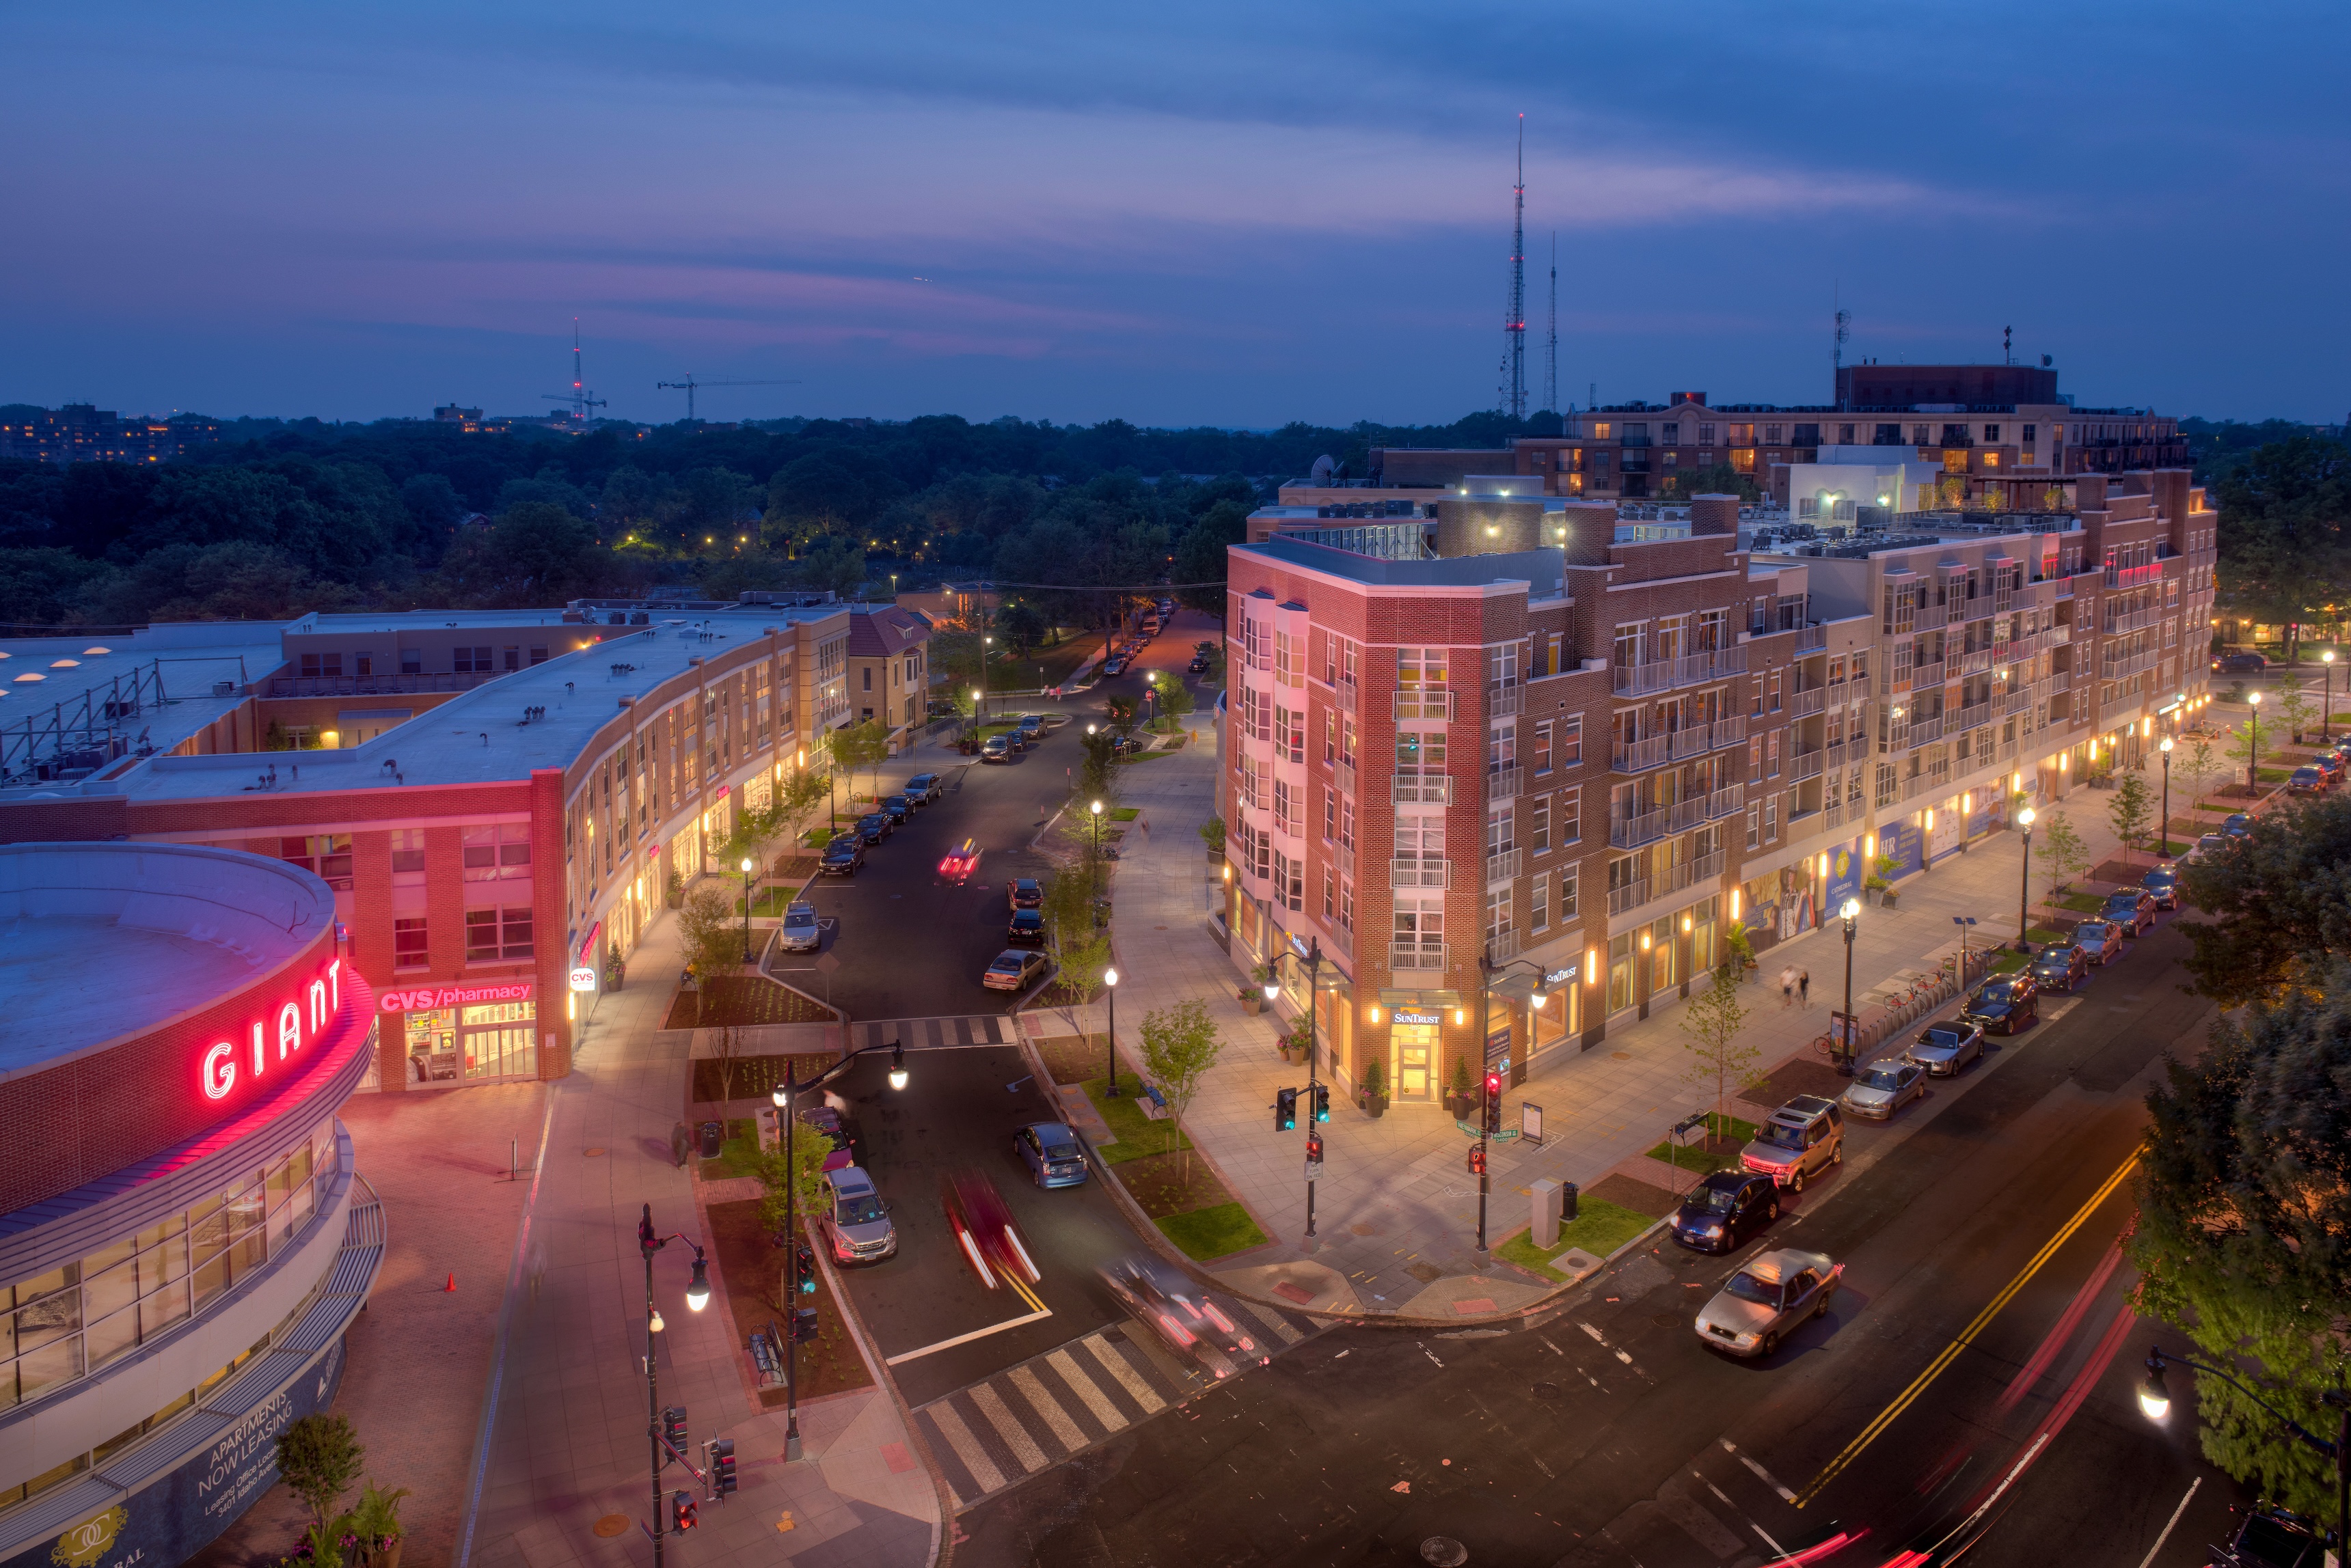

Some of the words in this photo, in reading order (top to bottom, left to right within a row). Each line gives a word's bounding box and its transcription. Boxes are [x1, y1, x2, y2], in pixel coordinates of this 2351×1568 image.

[1831, 881, 1853, 894] CATHEDRAL
[571, 973, 593, 982] CVS
[381, 985, 531, 1011] CVS/pharmacy
[1458, 1121, 1477, 1135] NEWARK
[210, 1392, 287, 1469] APARTMENTS
[198, 1450, 239, 1498] NOW
[241, 1400, 293, 1461] LEASING
[205, 1485, 235, 1516] Leasing
[236, 1464, 257, 1488] Office
[218, 1495, 236, 1517] 3401
[239, 1476, 258, 1499] Idaho
